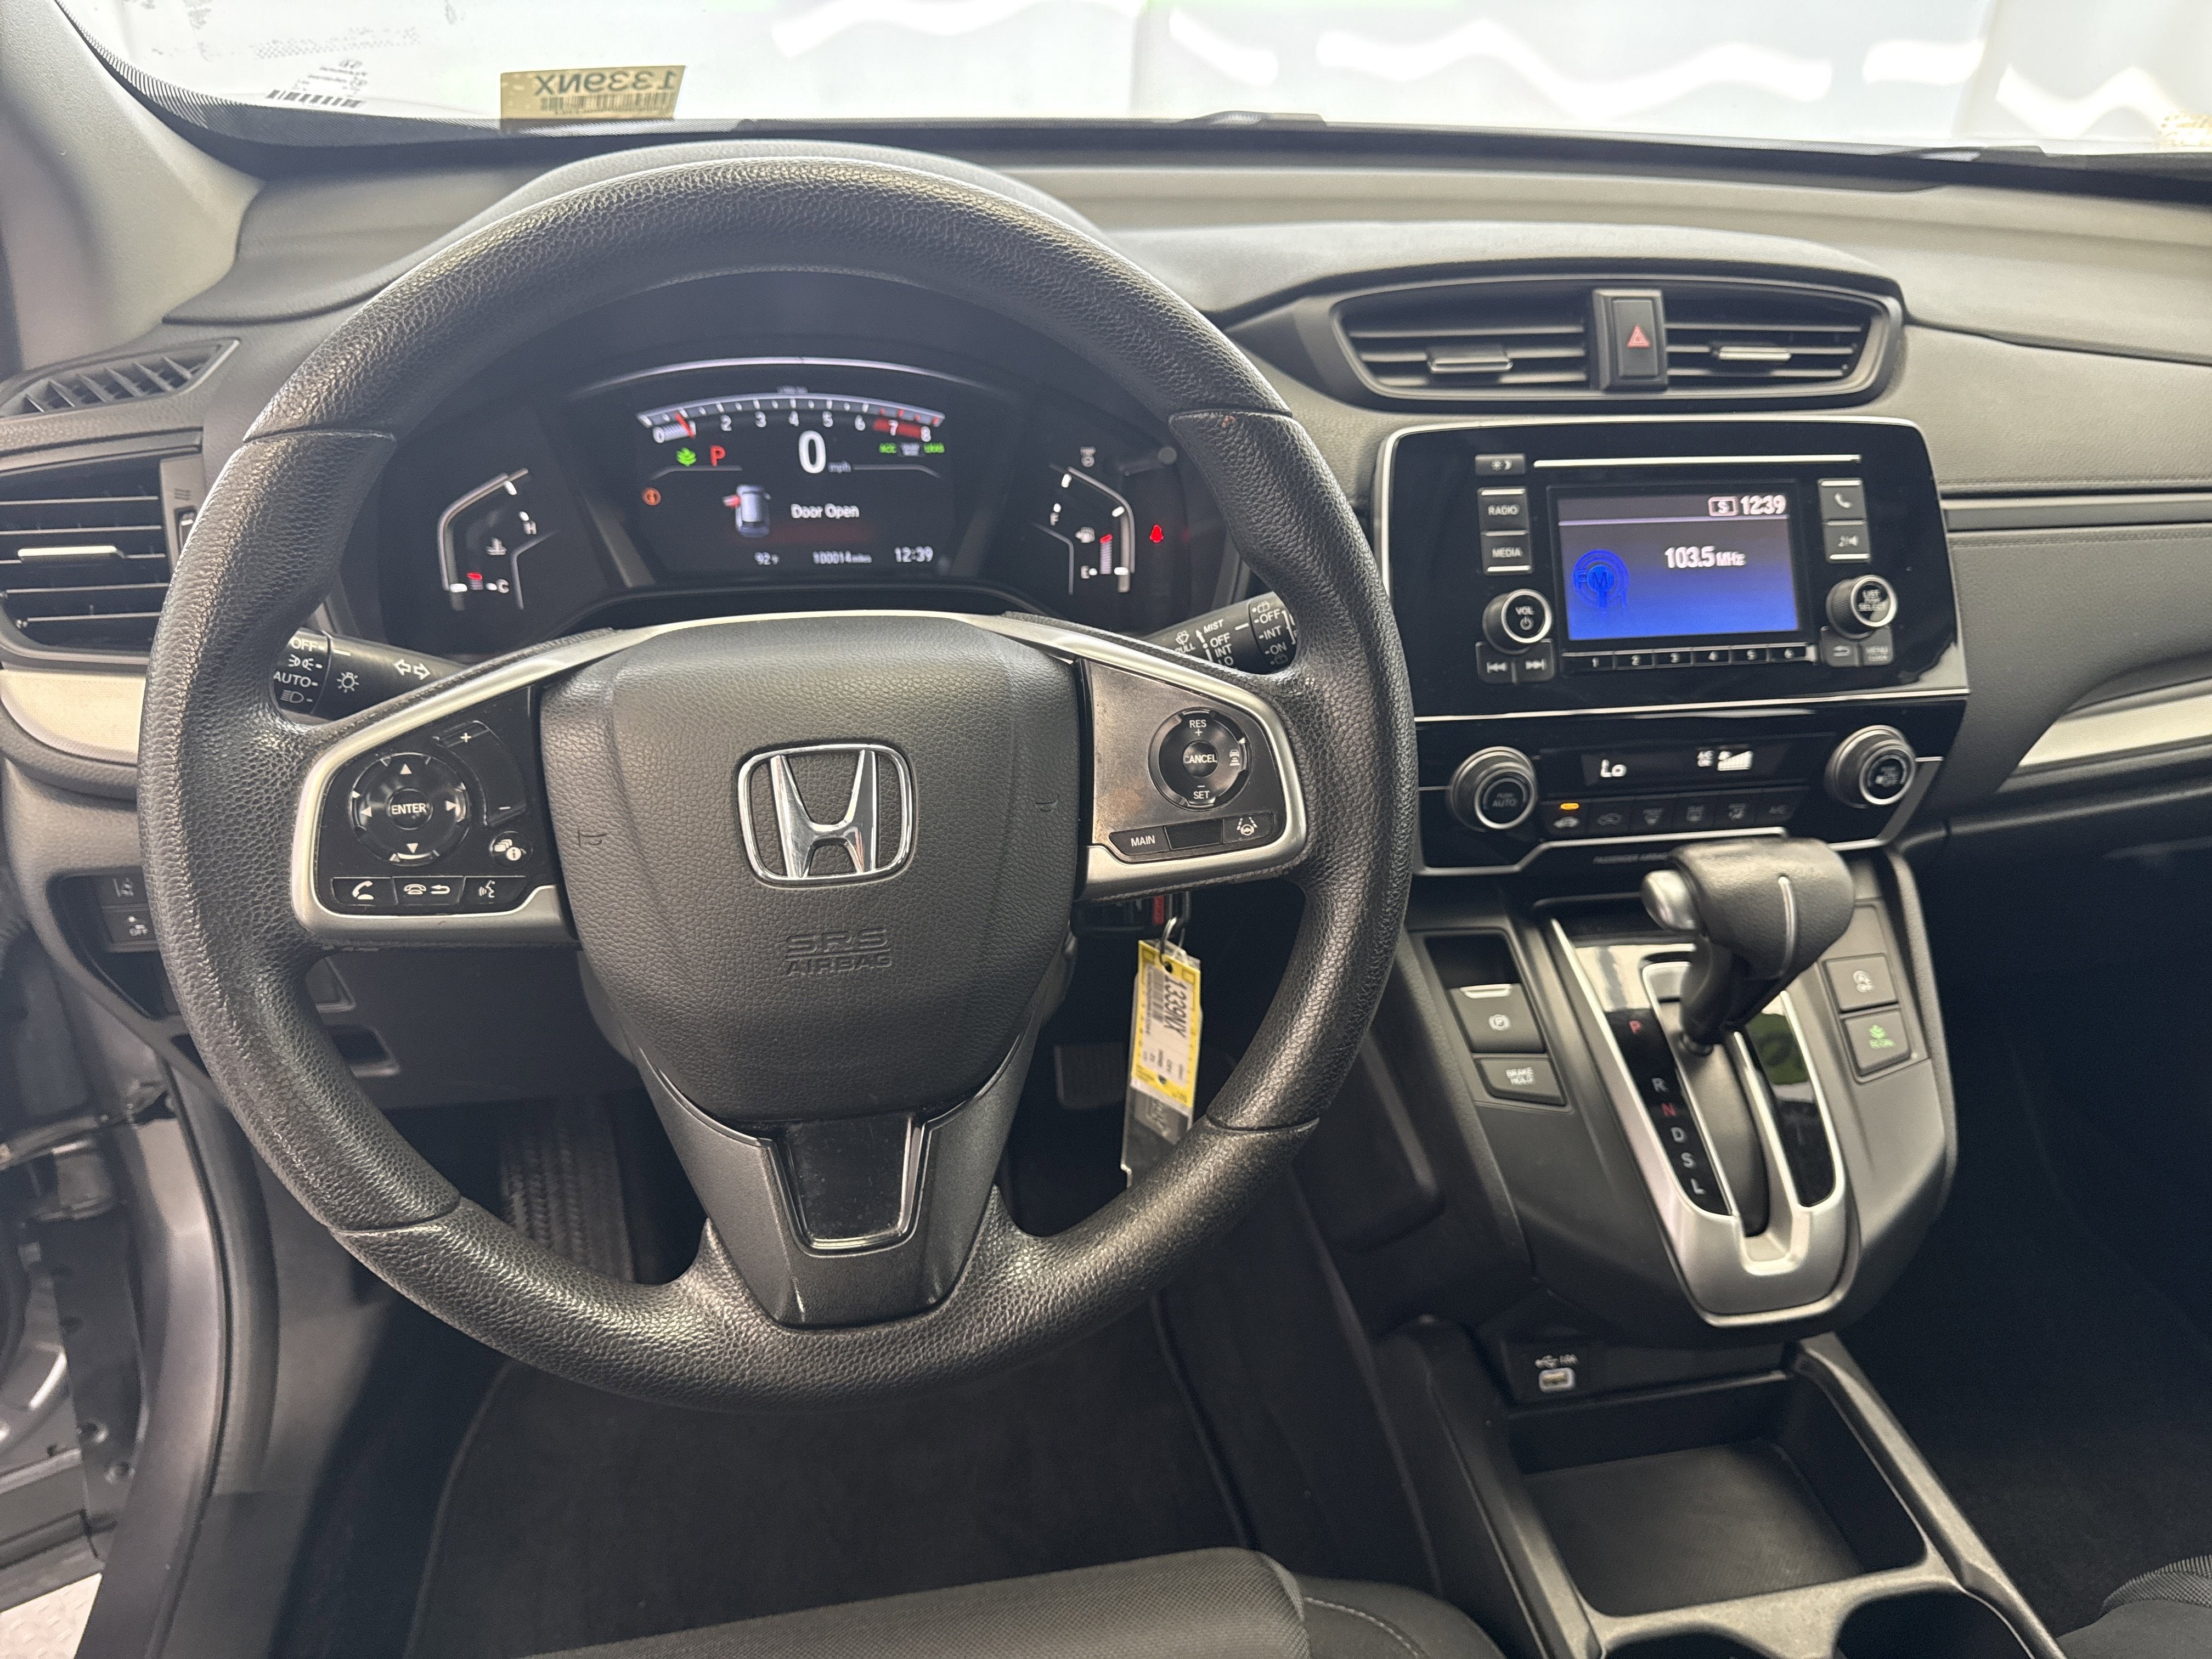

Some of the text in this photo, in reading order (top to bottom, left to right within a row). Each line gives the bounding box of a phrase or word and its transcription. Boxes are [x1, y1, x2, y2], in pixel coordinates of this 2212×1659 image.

[720, 415, 732, 431] 2
[755, 411, 767, 427] 3
[789, 411, 799, 426] 4
[822, 411, 833, 427] 5
[854, 415, 865, 431] 6
[888, 420, 898, 436] 7
[921, 426, 931, 442] 8
[710, 445, 726, 466] P
[798, 430, 851, 473] 0 mph
[791, 503, 859, 519] Door Open
[1488, 505, 1519, 516] RADIO
[523, 521, 537, 535] H
[894, 546, 933, 562] 12:39
[1492, 548, 1522, 558] MEDIA
[1664, 545, 1715, 568] 103.5
[497, 579, 509, 594] C
[1259, 609, 1281, 623] OFF
[1515, 606, 1534, 616] VOL
[1203, 619, 1224, 634] MIST
[1263, 625, 1282, 640] INT
[291, 636, 318, 651] OFF
[1210, 632, 1231, 647] OFF
[1215, 644, 1232, 657] INT
[1269, 642, 1287, 654] ON
[1592, 647, 1795, 668] 1 2 3 4 5 6
[273, 671, 311, 687] AUTO
[1189, 719, 1206, 729] RES
[1184, 754, 1217, 764] CANCEL
[1600, 759, 1627, 778] Lo
[1193, 790, 1210, 800] SET
[391, 802, 427, 816] ENTER
[1492, 798, 1519, 808] AUTO
[1131, 834, 1155, 847] MAIN
[786, 929, 888, 956] SRS
[787, 953, 893, 977] AIRBAG
[1164, 978, 1187, 1038] 1339NX
[1629, 1020, 1641, 1034] P
[1506, 1067, 1534, 1077] BRAKE
[1510, 1075, 1534, 1086] HOLD
[1652, 1077, 1668, 1093] R
[1661, 1103, 1677, 1116] N
[1671, 1127, 1685, 1143] D
[1681, 1152, 1696, 1169] S
[1690, 1178, 1706, 1194] L
